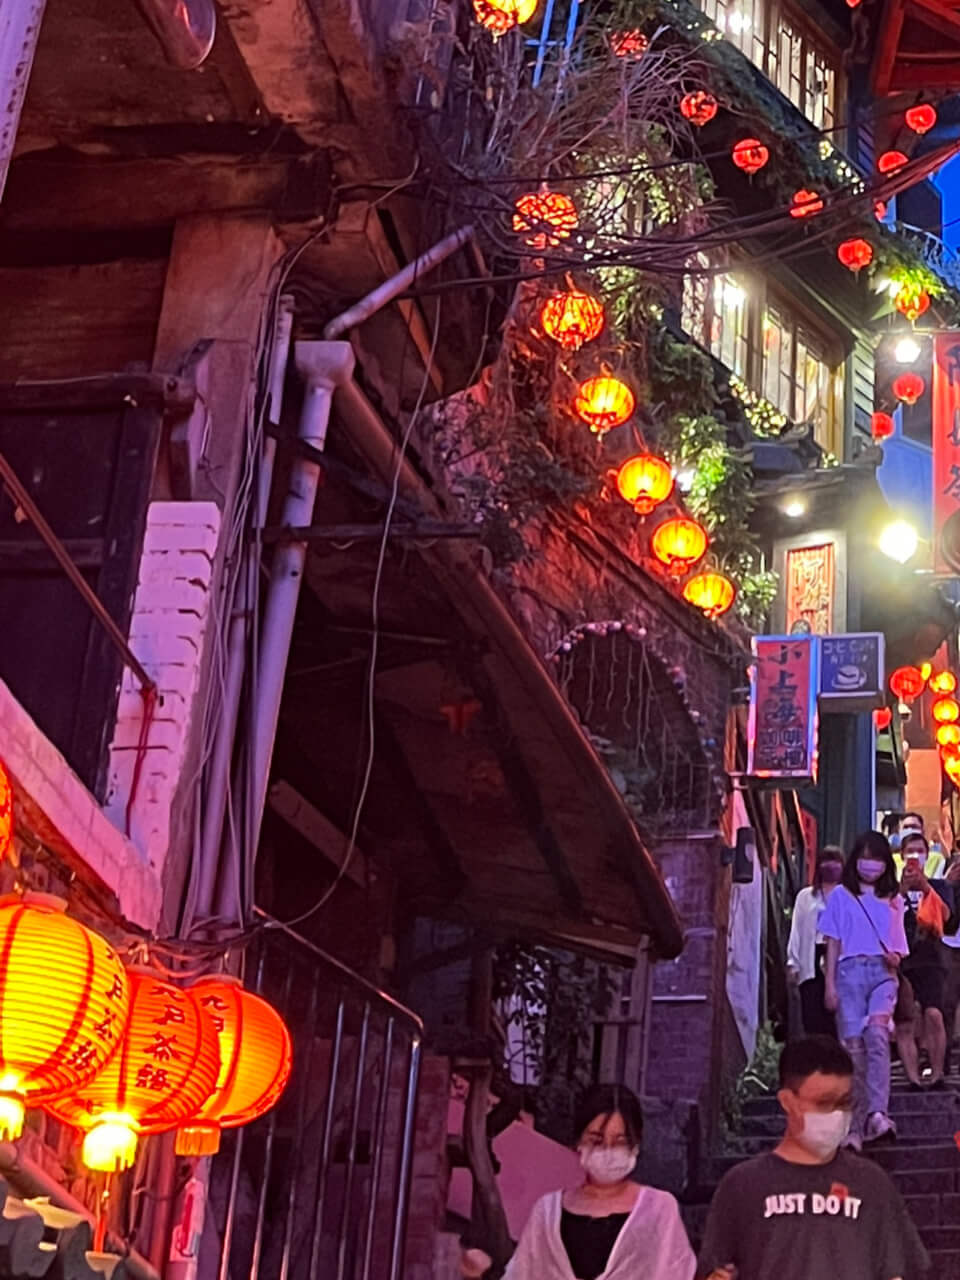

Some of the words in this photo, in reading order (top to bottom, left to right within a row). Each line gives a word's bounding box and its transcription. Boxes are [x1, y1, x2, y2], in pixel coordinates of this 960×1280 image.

[764, 1193, 807, 1218] JUST
[812, 1193, 840, 1215] DO
[844, 1195, 862, 1219] IT
